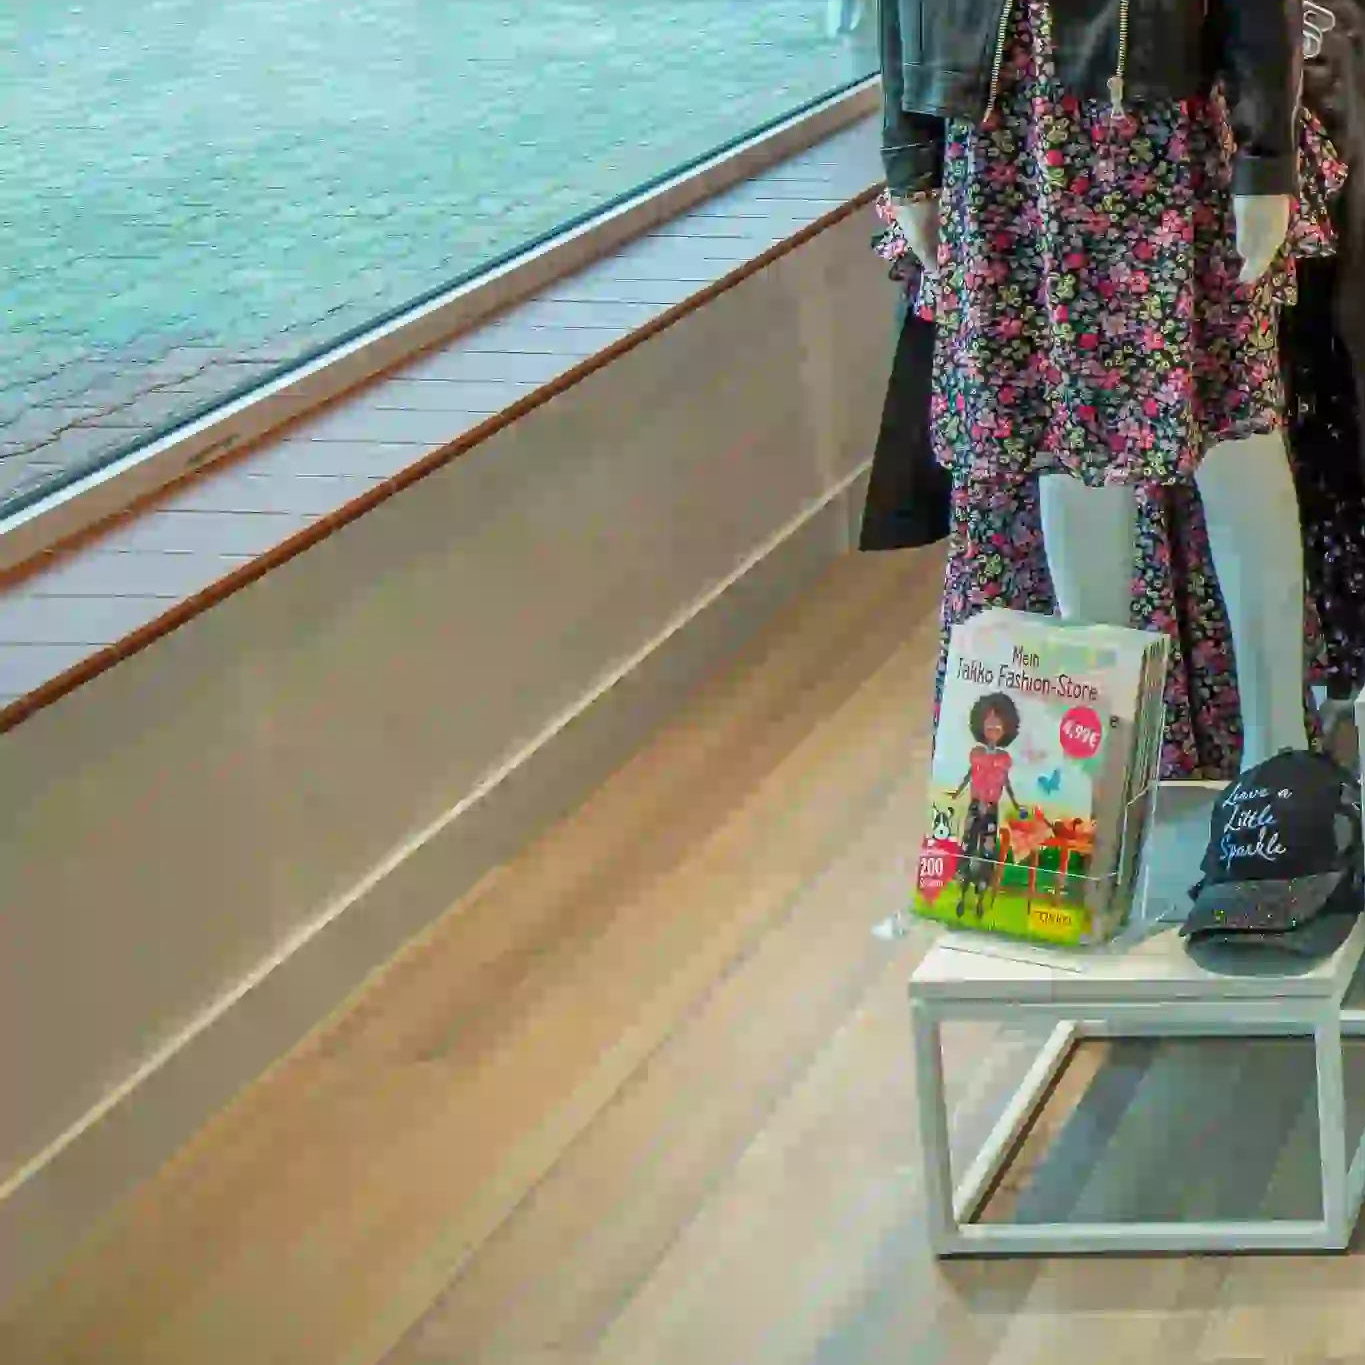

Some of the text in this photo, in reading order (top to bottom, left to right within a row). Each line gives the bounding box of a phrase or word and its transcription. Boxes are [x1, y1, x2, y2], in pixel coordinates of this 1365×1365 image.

[1012, 644, 1040, 668] Mein
[957, 656, 1099, 702] Takko Fashion-Store
[1223, 803, 1277, 834] Little
[1219, 826, 1287, 871] Sparkle
[920, 856, 944, 877] 200
